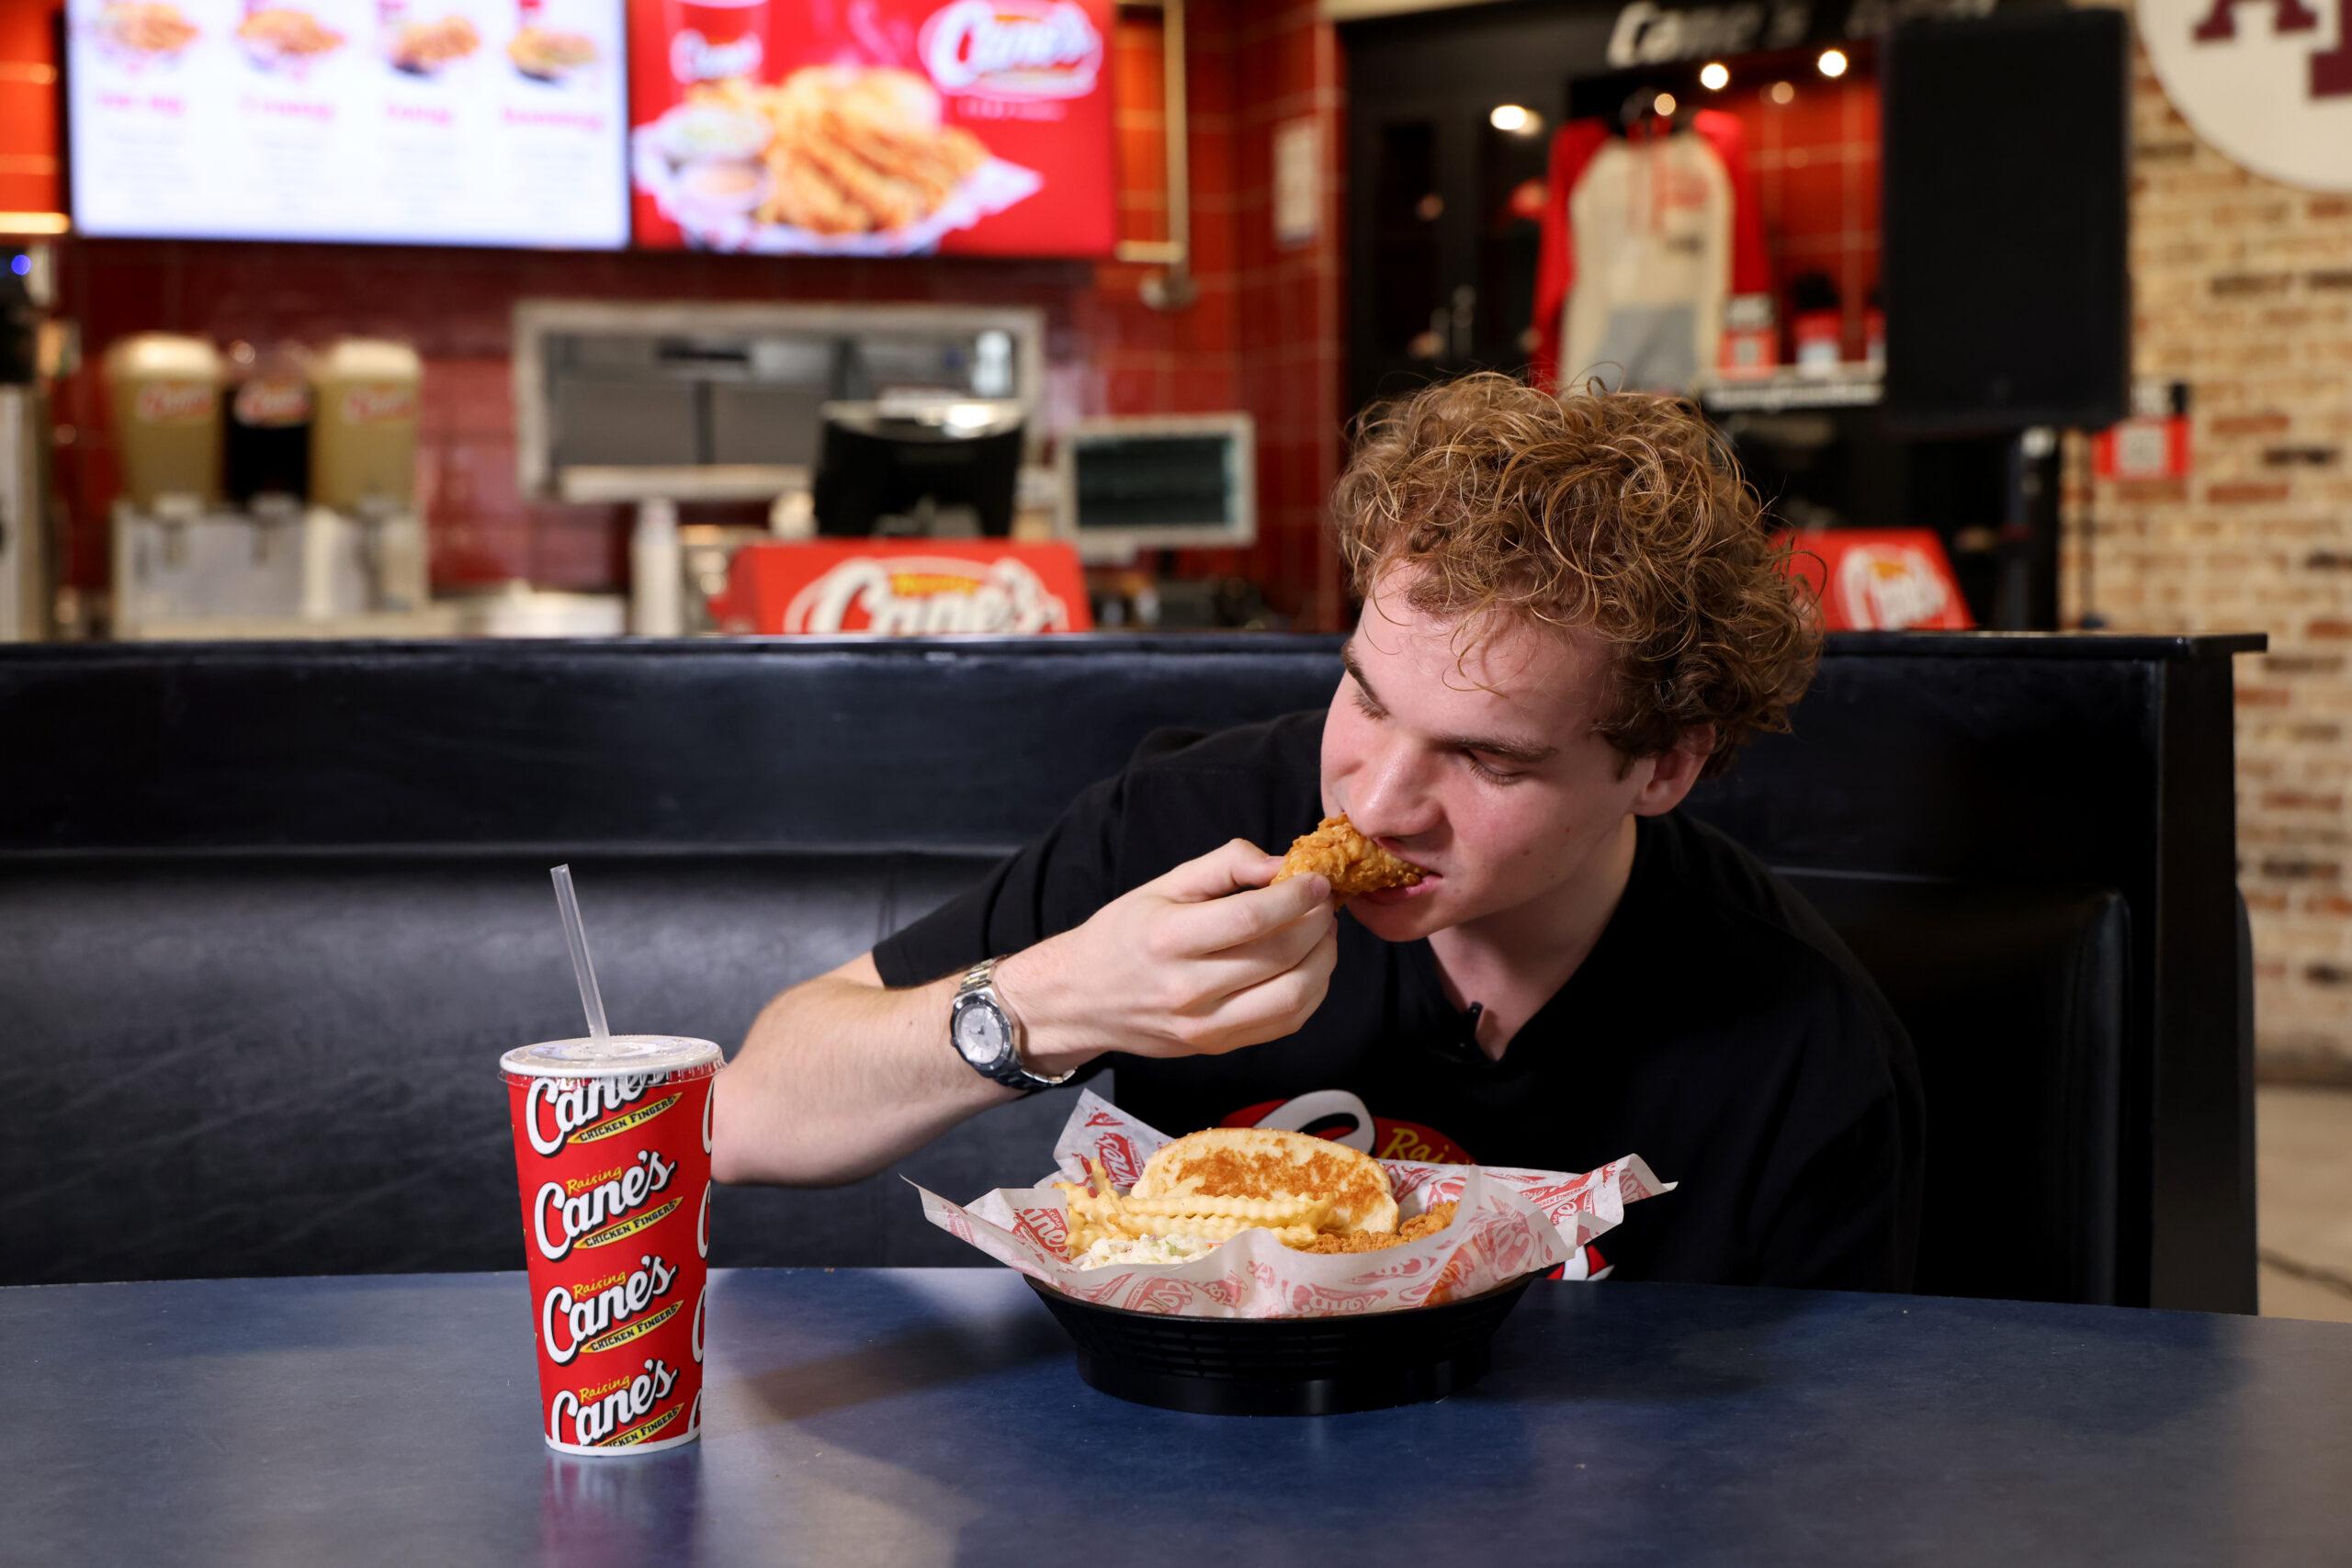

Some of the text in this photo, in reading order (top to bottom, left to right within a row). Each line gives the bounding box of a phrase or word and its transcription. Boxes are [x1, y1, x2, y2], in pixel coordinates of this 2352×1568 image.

[579, 1097, 674, 1143] CHICKEN FINGERS
[566, 1167, 623, 1195] Raising
[534, 1150, 676, 1260] Cane's
[585, 1201, 676, 1247] CHICKEN FINGERS
[573, 1271, 627, 1300] Raising
[542, 1255, 677, 1364] Cane's
[591, 1306, 677, 1352] CHICKEN FINGERS
[551, 1359, 678, 1447] Cane's
[579, 1375, 631, 1404] Raising
[640, 1408, 678, 1437] FINGERS
